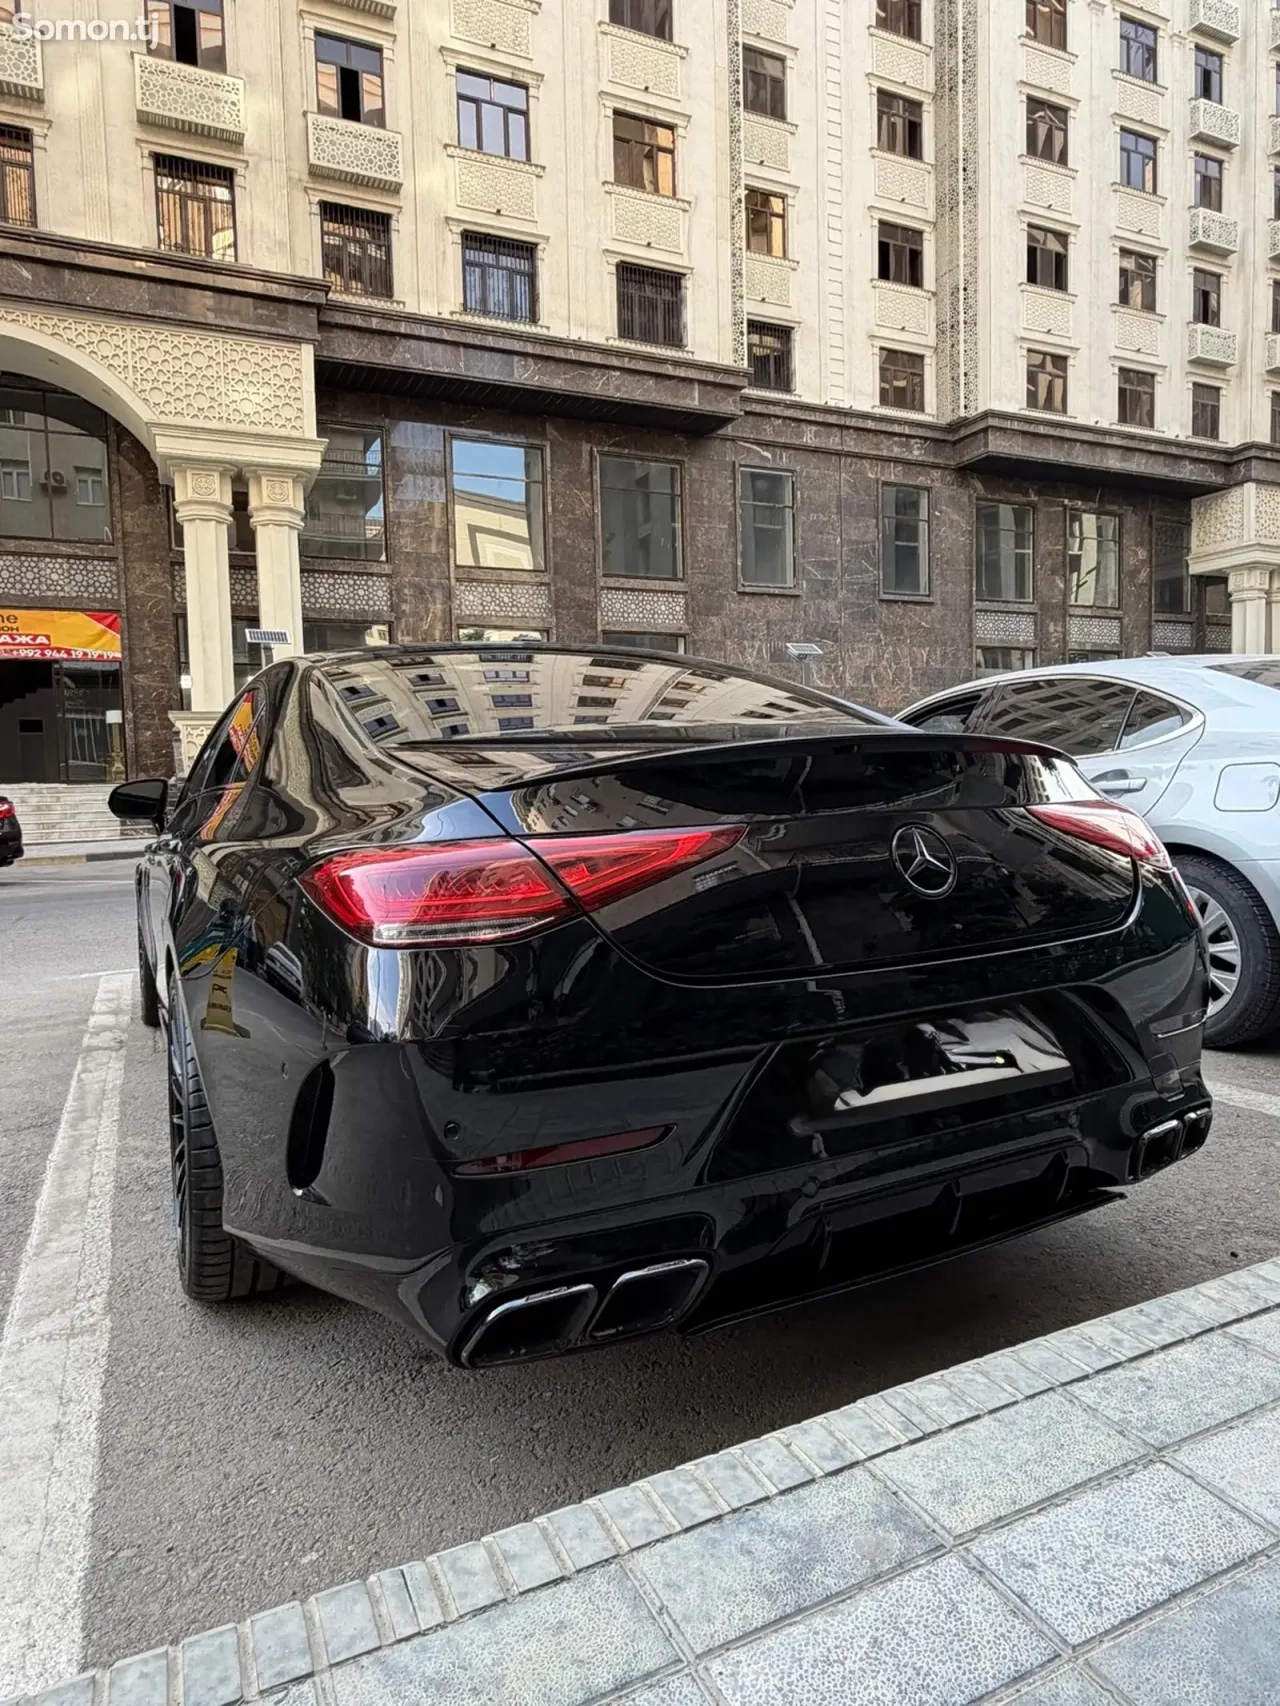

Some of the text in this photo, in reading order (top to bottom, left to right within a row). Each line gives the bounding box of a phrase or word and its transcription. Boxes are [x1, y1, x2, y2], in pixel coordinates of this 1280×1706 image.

[0, 634, 49, 644] АЖА
[12, 649, 41, 658] +992
[44, 649, 68, 658] 944
[72, 650, 83, 659] 19
